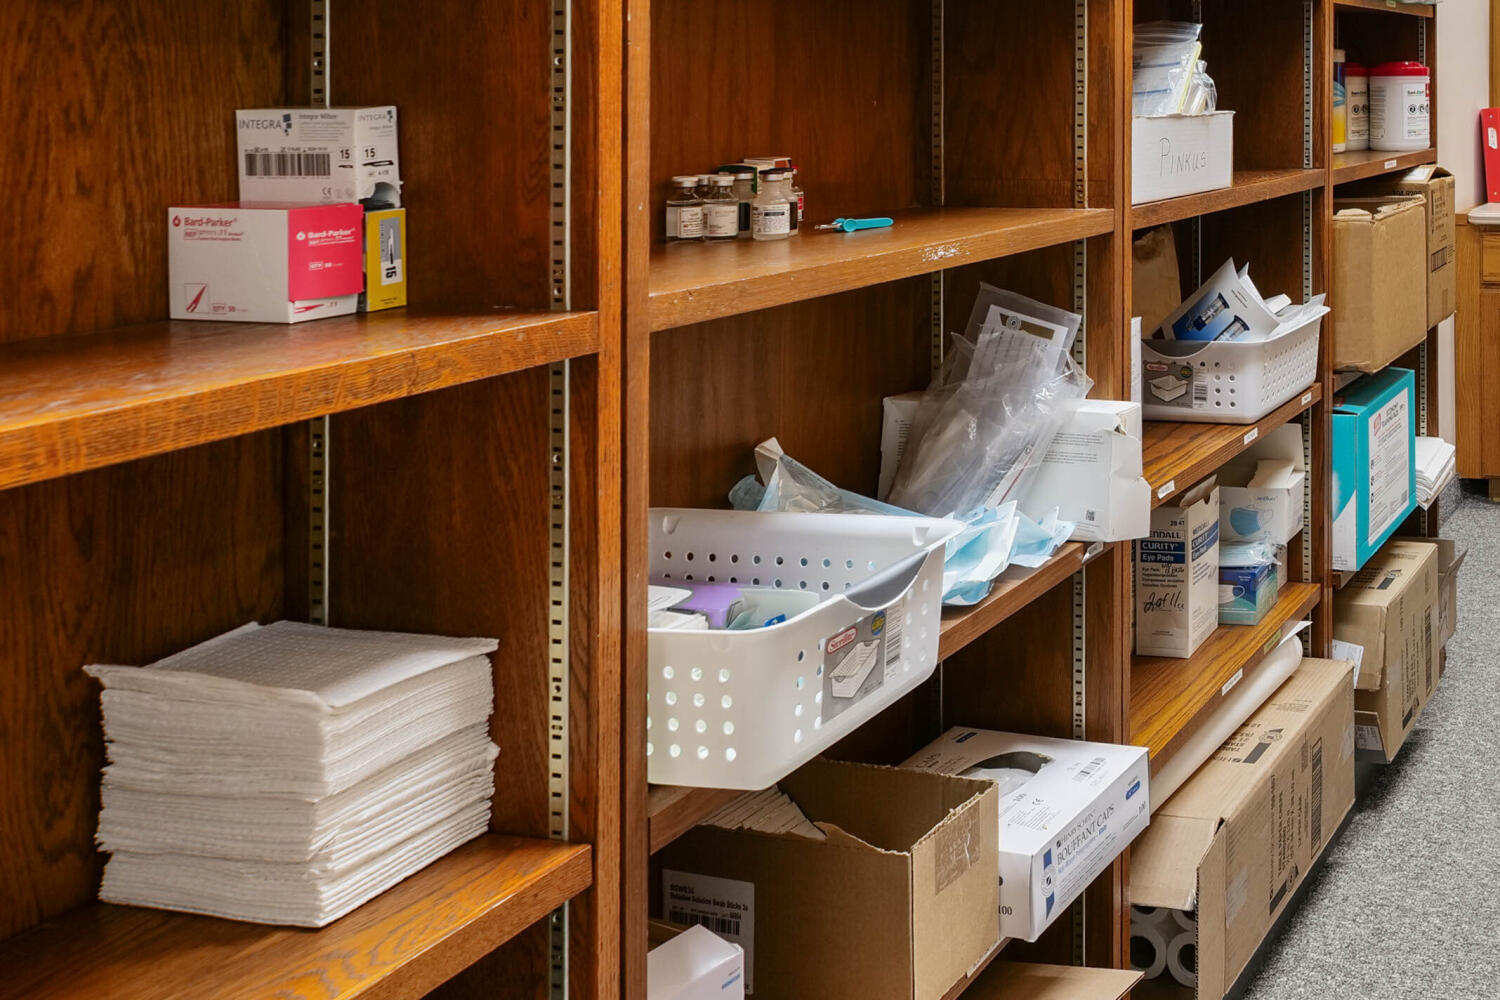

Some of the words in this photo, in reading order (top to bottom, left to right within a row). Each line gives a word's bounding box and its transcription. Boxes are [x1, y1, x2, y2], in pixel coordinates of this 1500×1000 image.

[358, 113, 387, 121] INTEGRA
[239, 119, 282, 130] INTEGRA
[340, 149, 350, 160] 15
[364, 148, 375, 158] 15
[385, 266, 397, 279] 15
[1150, 530, 1181, 539] ENDALL
[1156, 554, 1174, 562] Pads
[1057, 824, 1096, 866] BOUFFANT
[1096, 803, 1114, 827] CAPS
